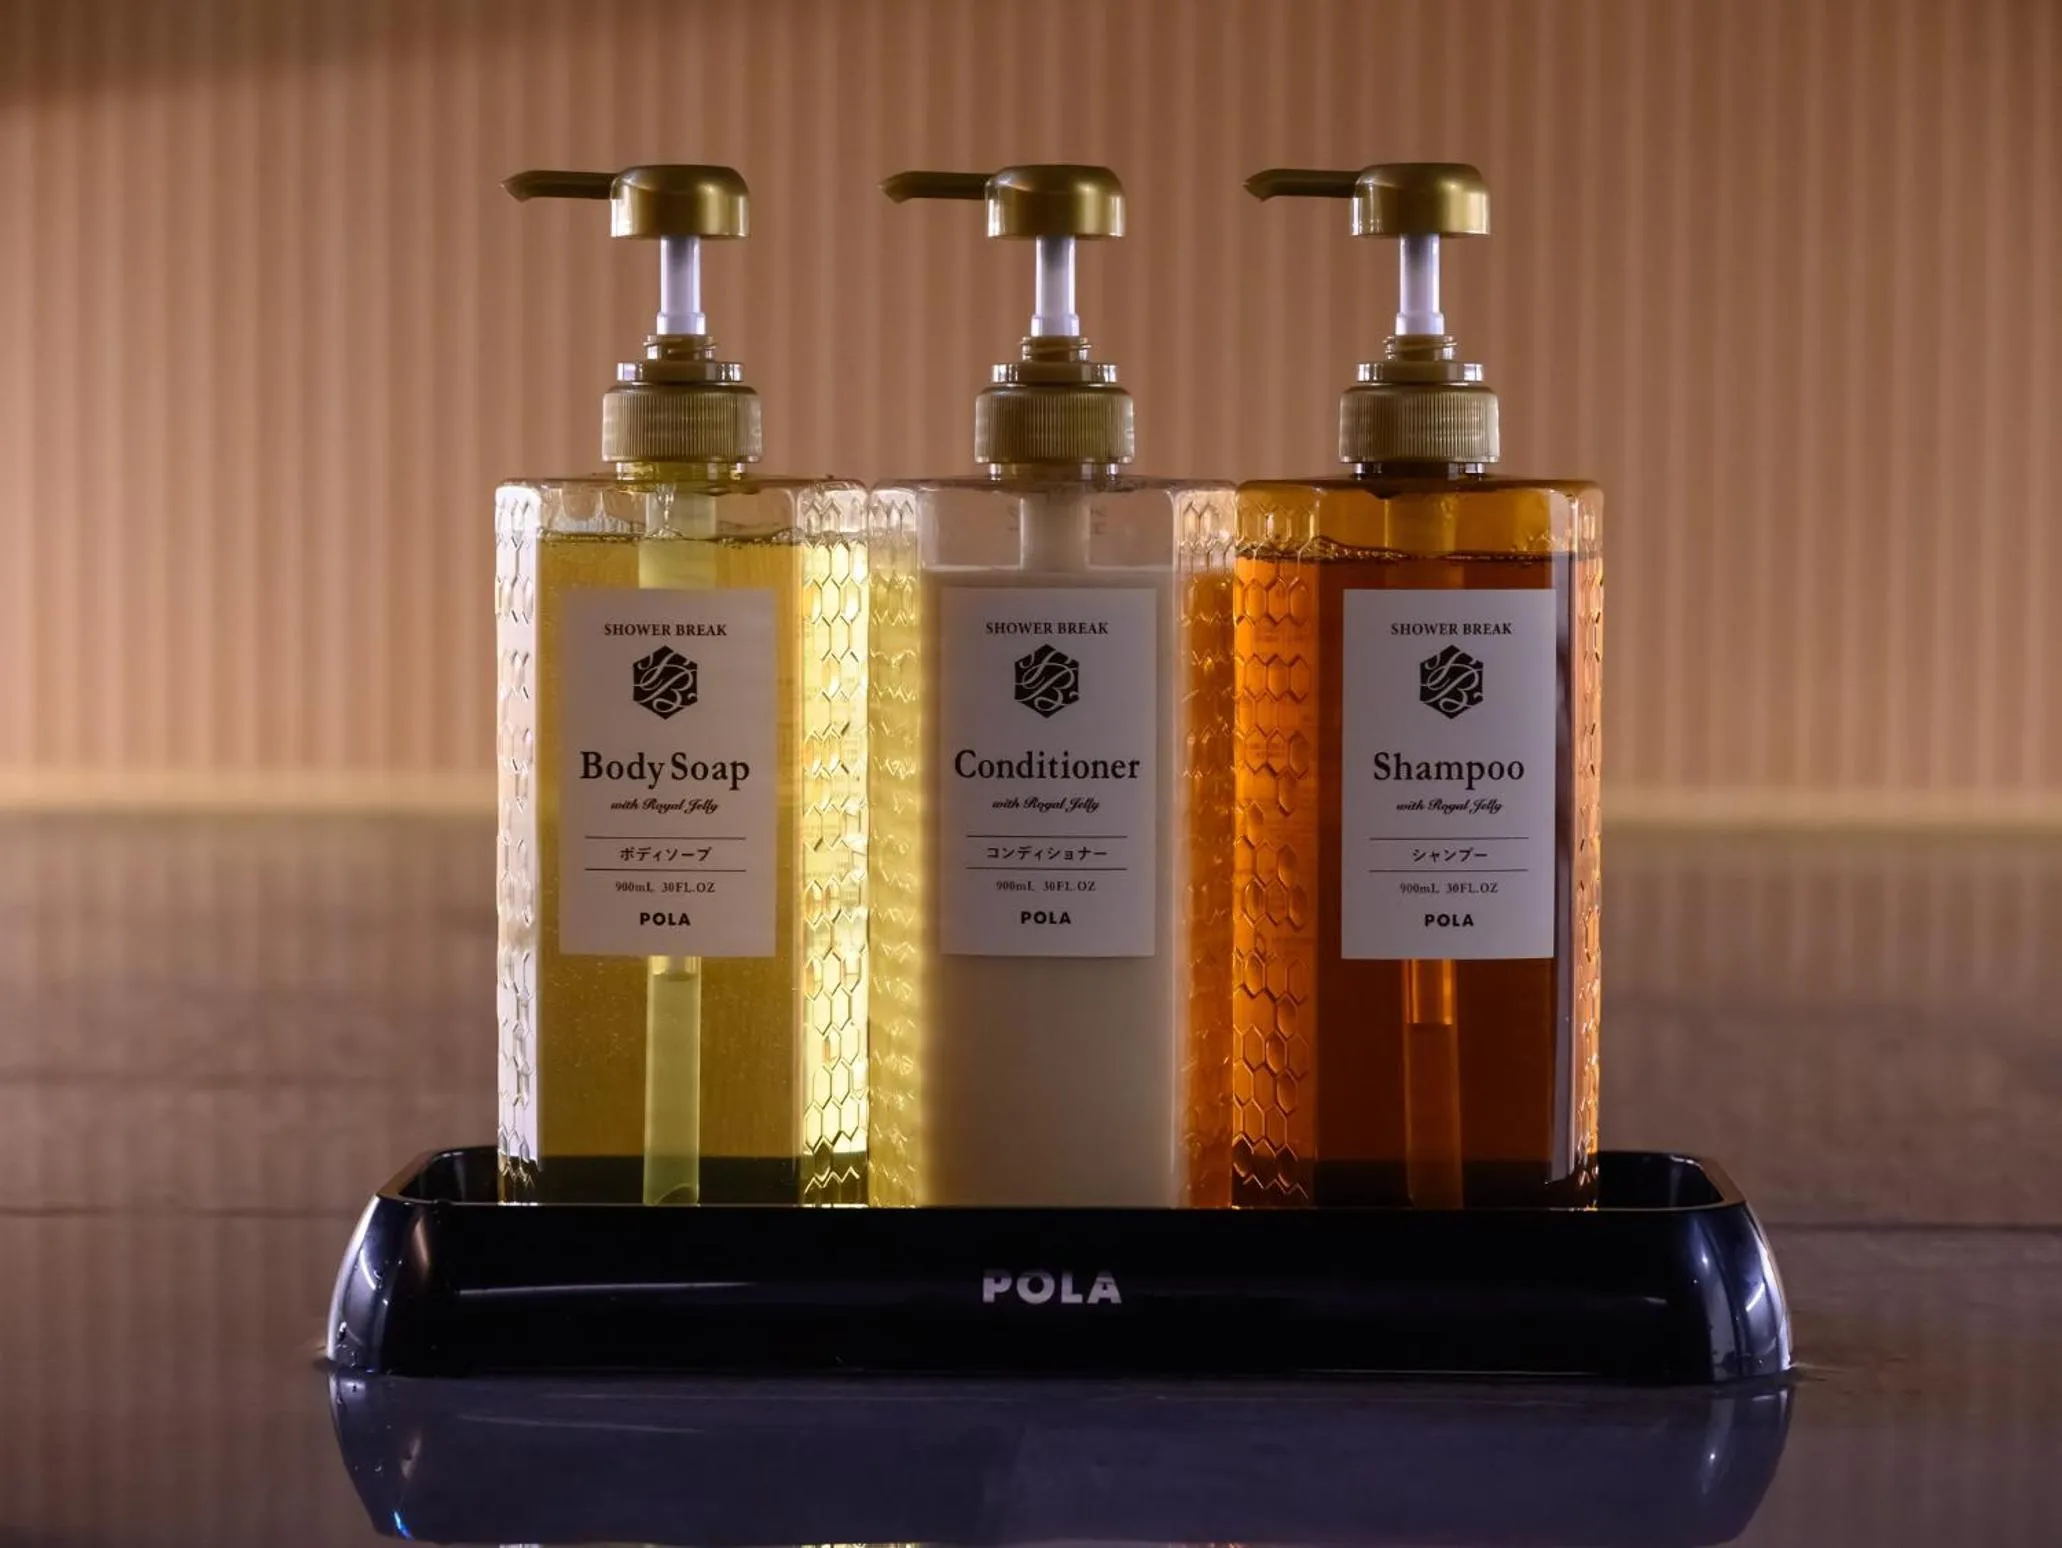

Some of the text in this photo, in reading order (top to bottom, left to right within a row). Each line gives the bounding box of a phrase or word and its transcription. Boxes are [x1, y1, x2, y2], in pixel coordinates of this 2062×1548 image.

[604, 623, 728, 637] SHOWER BREAK
[985, 621, 1109, 635] SHOWER BREAK
[1390, 622, 1512, 636] SHOWER BREAK
[579, 750, 751, 792] Body Soap
[954, 749, 1141, 780] Conditioner
[1373, 751, 1525, 791] Shampoo
[610, 797, 719, 815] with Royal Jelly
[991, 796, 1101, 814] with Royal Jelly
[1395, 797, 1503, 816] with Royal Jelly
[619, 846, 713, 863] ボディソープ
[986, 845, 1108, 863] コンディショナー
[1412, 846, 1488, 864] シャンプー
[639, 911, 692, 927] POLA
[1020, 910, 1072, 925] POLA
[1424, 912, 1475, 928] POLA
[982, 1269, 1122, 1304] POLA
